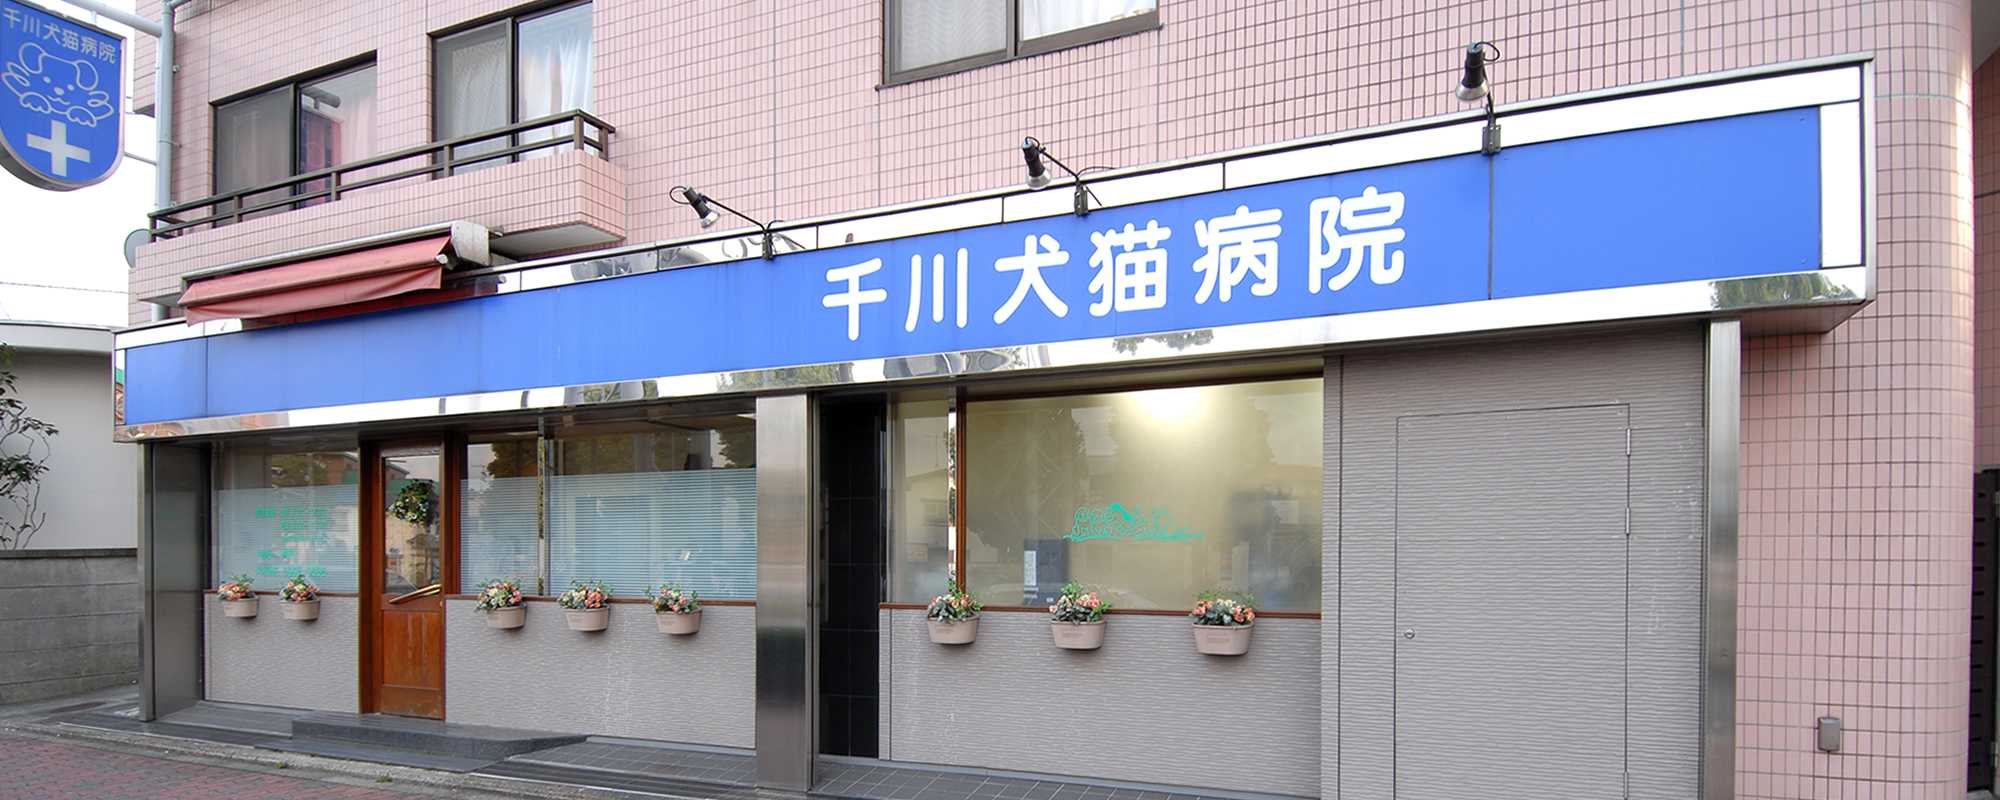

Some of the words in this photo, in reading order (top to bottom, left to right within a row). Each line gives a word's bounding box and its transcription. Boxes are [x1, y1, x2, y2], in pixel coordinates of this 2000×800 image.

[2, 7, 116, 64] 千川犬猫病院
[822, 186, 1406, 341] 千川犬猫病院
